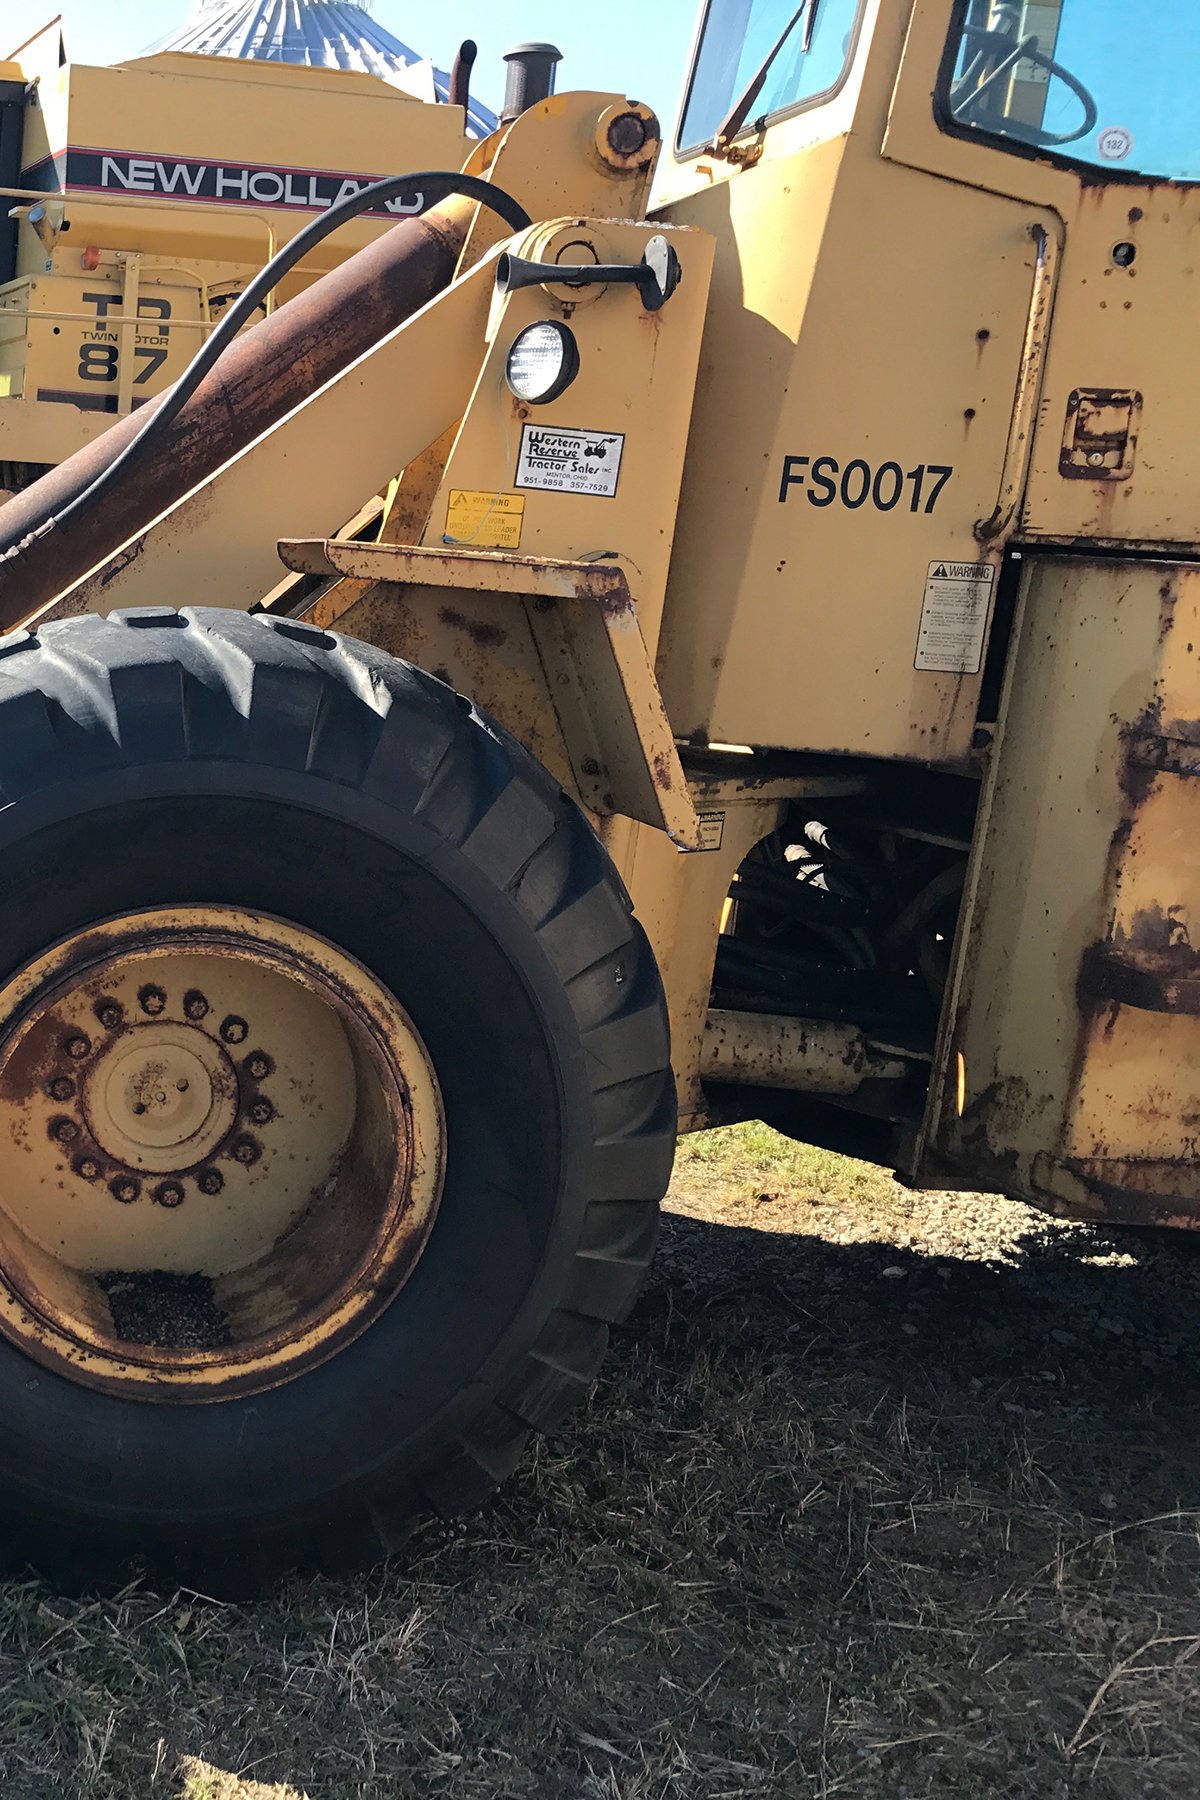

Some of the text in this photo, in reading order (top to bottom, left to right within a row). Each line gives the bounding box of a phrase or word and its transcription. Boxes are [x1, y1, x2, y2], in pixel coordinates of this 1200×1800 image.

[101, 156, 206, 196] NEW
[81, 331, 118, 342] TWIN
[78, 343, 169, 385] 87
[528, 431, 583, 449] Western
[528, 443, 579, 460] Reserve
[526, 456, 567, 471] Tractor
[571, 461, 599, 474] Sales
[524, 476, 608, 492] 951-9858 357-7529
[778, 455, 953, 514] FS0017
[949, 565, 990, 579] WARNING
